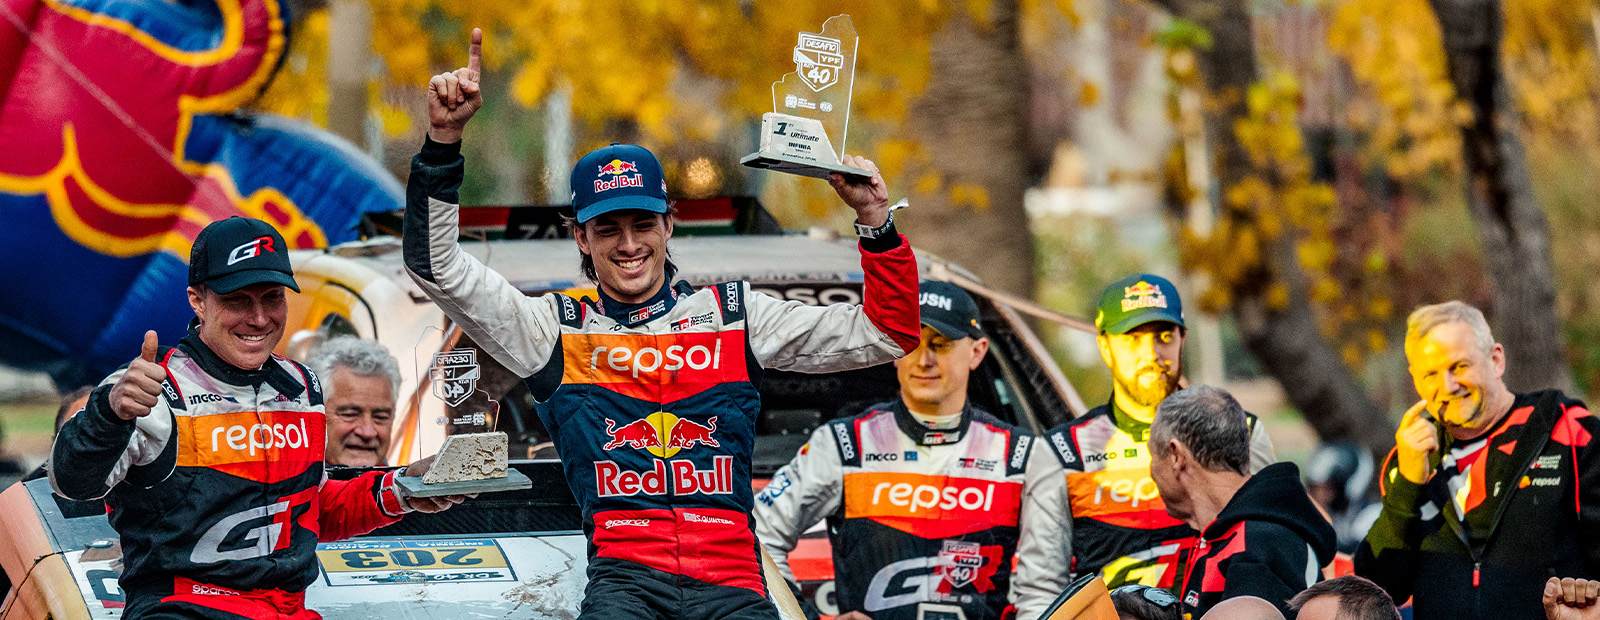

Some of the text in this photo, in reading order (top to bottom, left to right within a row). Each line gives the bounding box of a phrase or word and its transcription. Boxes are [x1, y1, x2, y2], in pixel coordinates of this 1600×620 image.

[821, 56, 841, 64] YPF
[807, 67, 831, 84] 40
[773, 121, 788, 136] 1
[790, 131, 820, 142] Ultimate
[788, 141, 812, 151] INFINIA
[594, 176, 619, 193] Red
[619, 173, 644, 188] Bull
[227, 235, 276, 267] GR
[918, 291, 952, 312] USN
[1121, 294, 1168, 313] Red Bull
[630, 310, 649, 323] GR
[591, 338, 721, 378] repsol
[211, 418, 310, 456] repsol
[594, 458, 667, 498] Red
[670, 455, 734, 497] Bull
[1531, 476, 1561, 487] repsol
[872, 482, 995, 513] repsol
[1094, 477, 1160, 508] rep
[605, 519, 651, 530] sparco
[341, 548, 484, 569] 203
[863, 545, 1004, 612] GR
[950, 567, 971, 581] 40
[1184, 594, 1199, 607] GR
